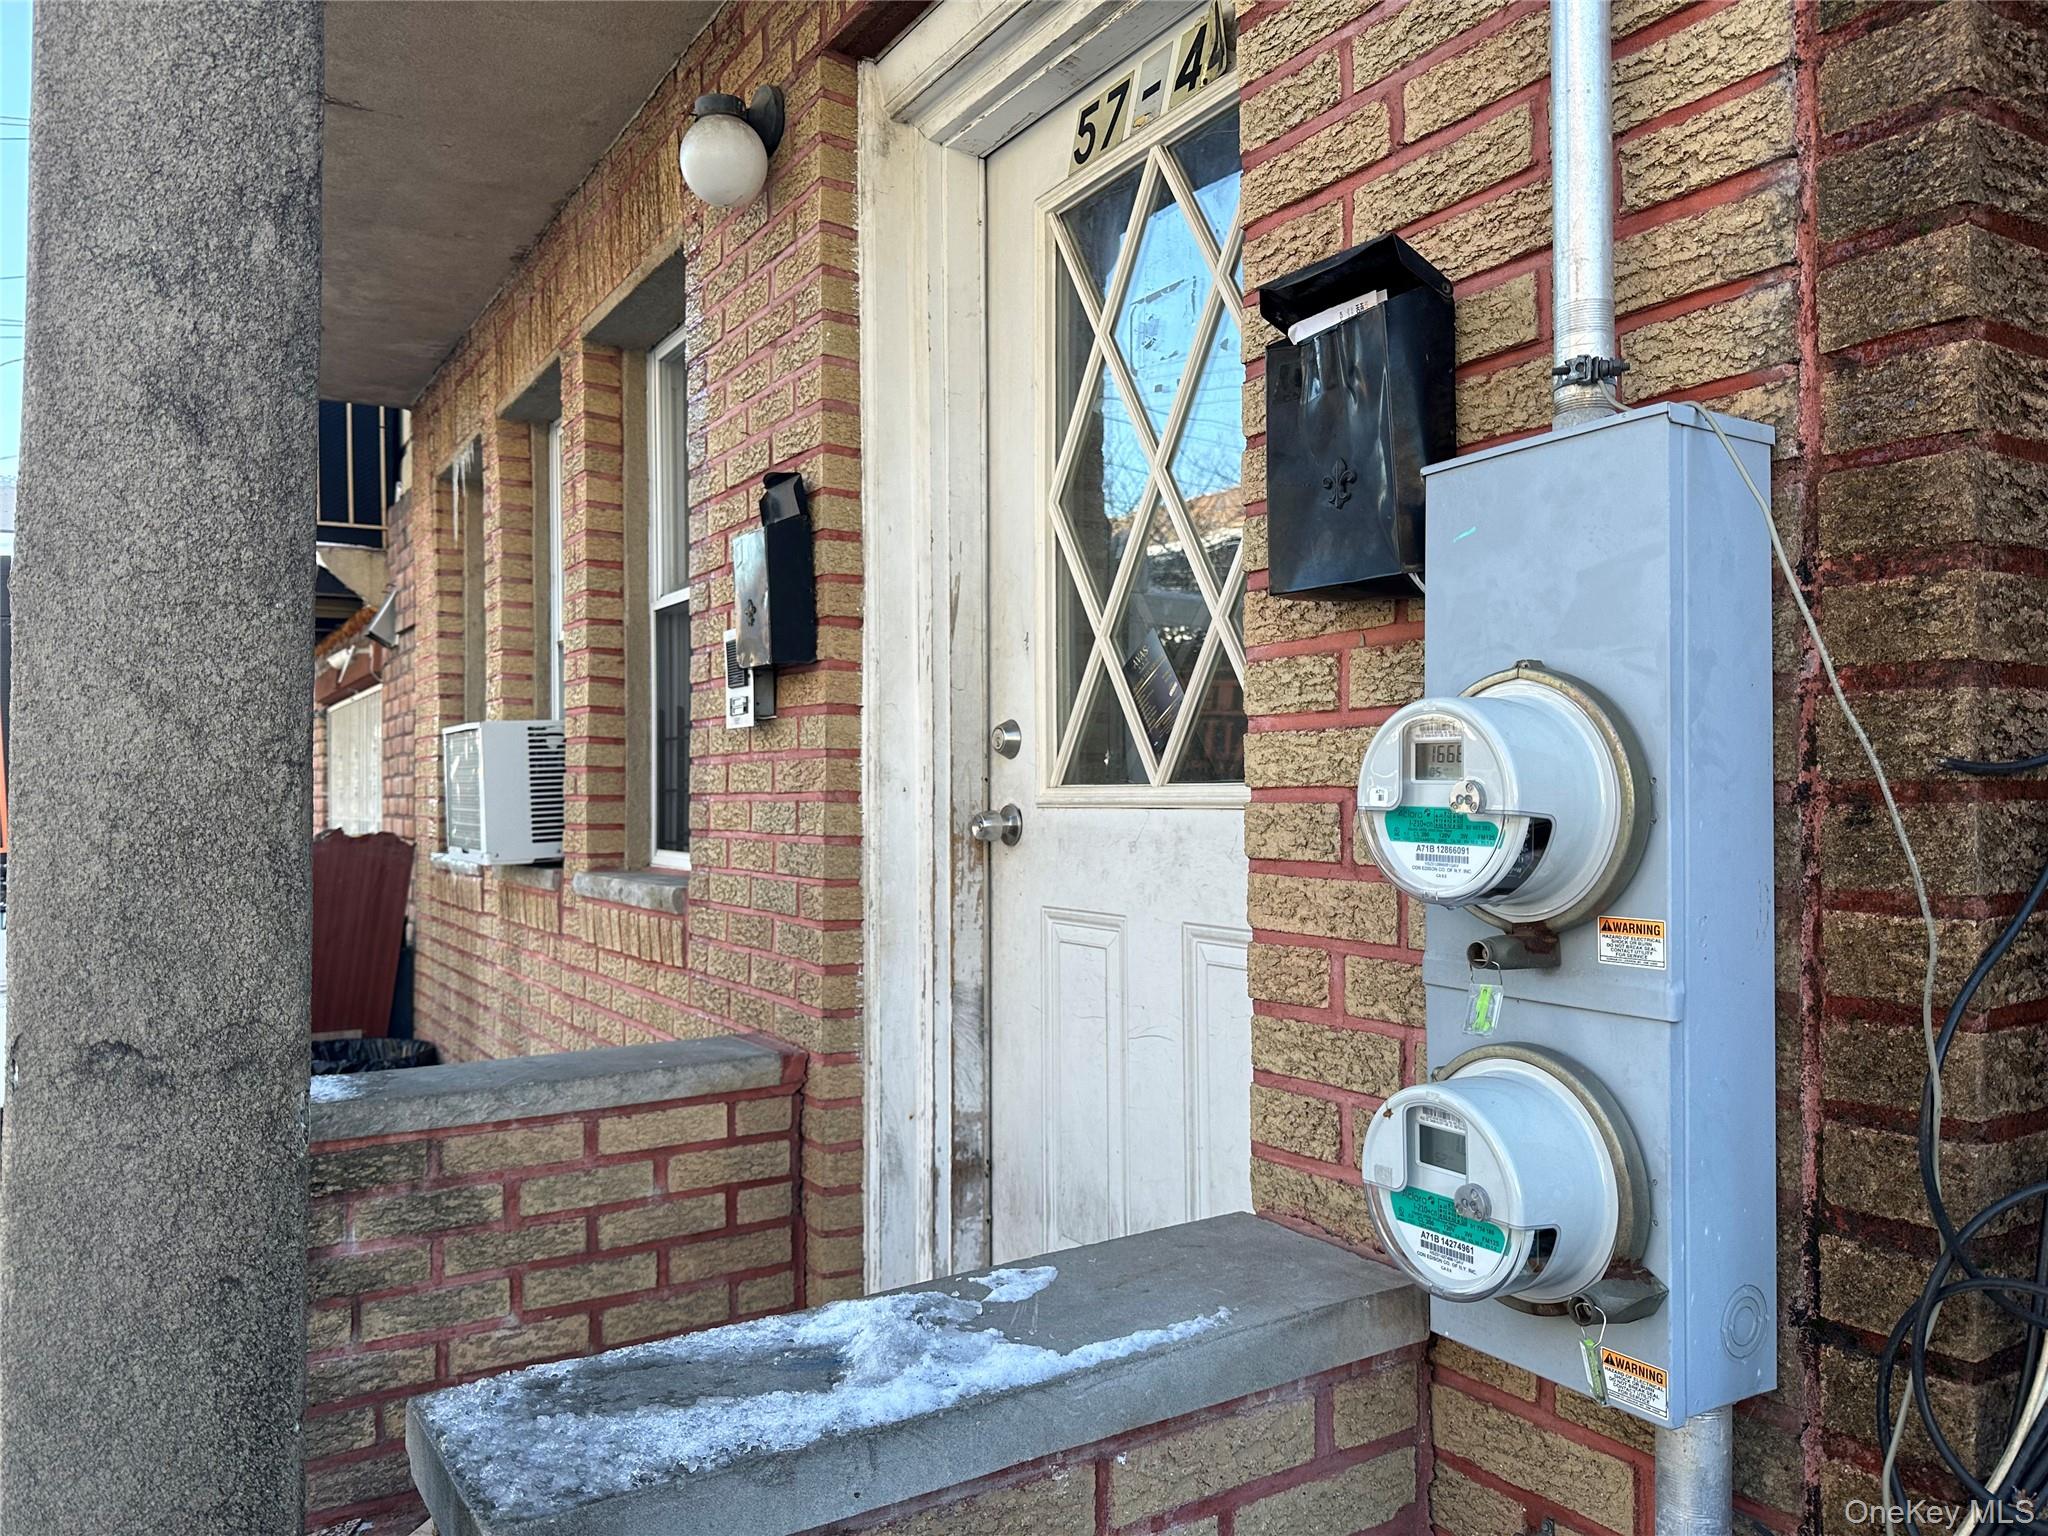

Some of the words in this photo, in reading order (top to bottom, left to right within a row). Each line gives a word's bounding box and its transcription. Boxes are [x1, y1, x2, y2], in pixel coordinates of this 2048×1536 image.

[1415, 844, 1435, 853] A71B
[1437, 846, 1470, 855] 12866091
[1612, 921, 1661, 936] WARNING
[1420, 1231, 1439, 1243] A71B
[1441, 1237, 1474, 1255] 14274961
[1604, 1366, 1625, 1377] HAZARD
[1633, 1376, 1664, 1392] ELECTRICAL
[1615, 1356, 1663, 1385] WARNING
[1612, 1382, 1636, 1393] CONTACT
